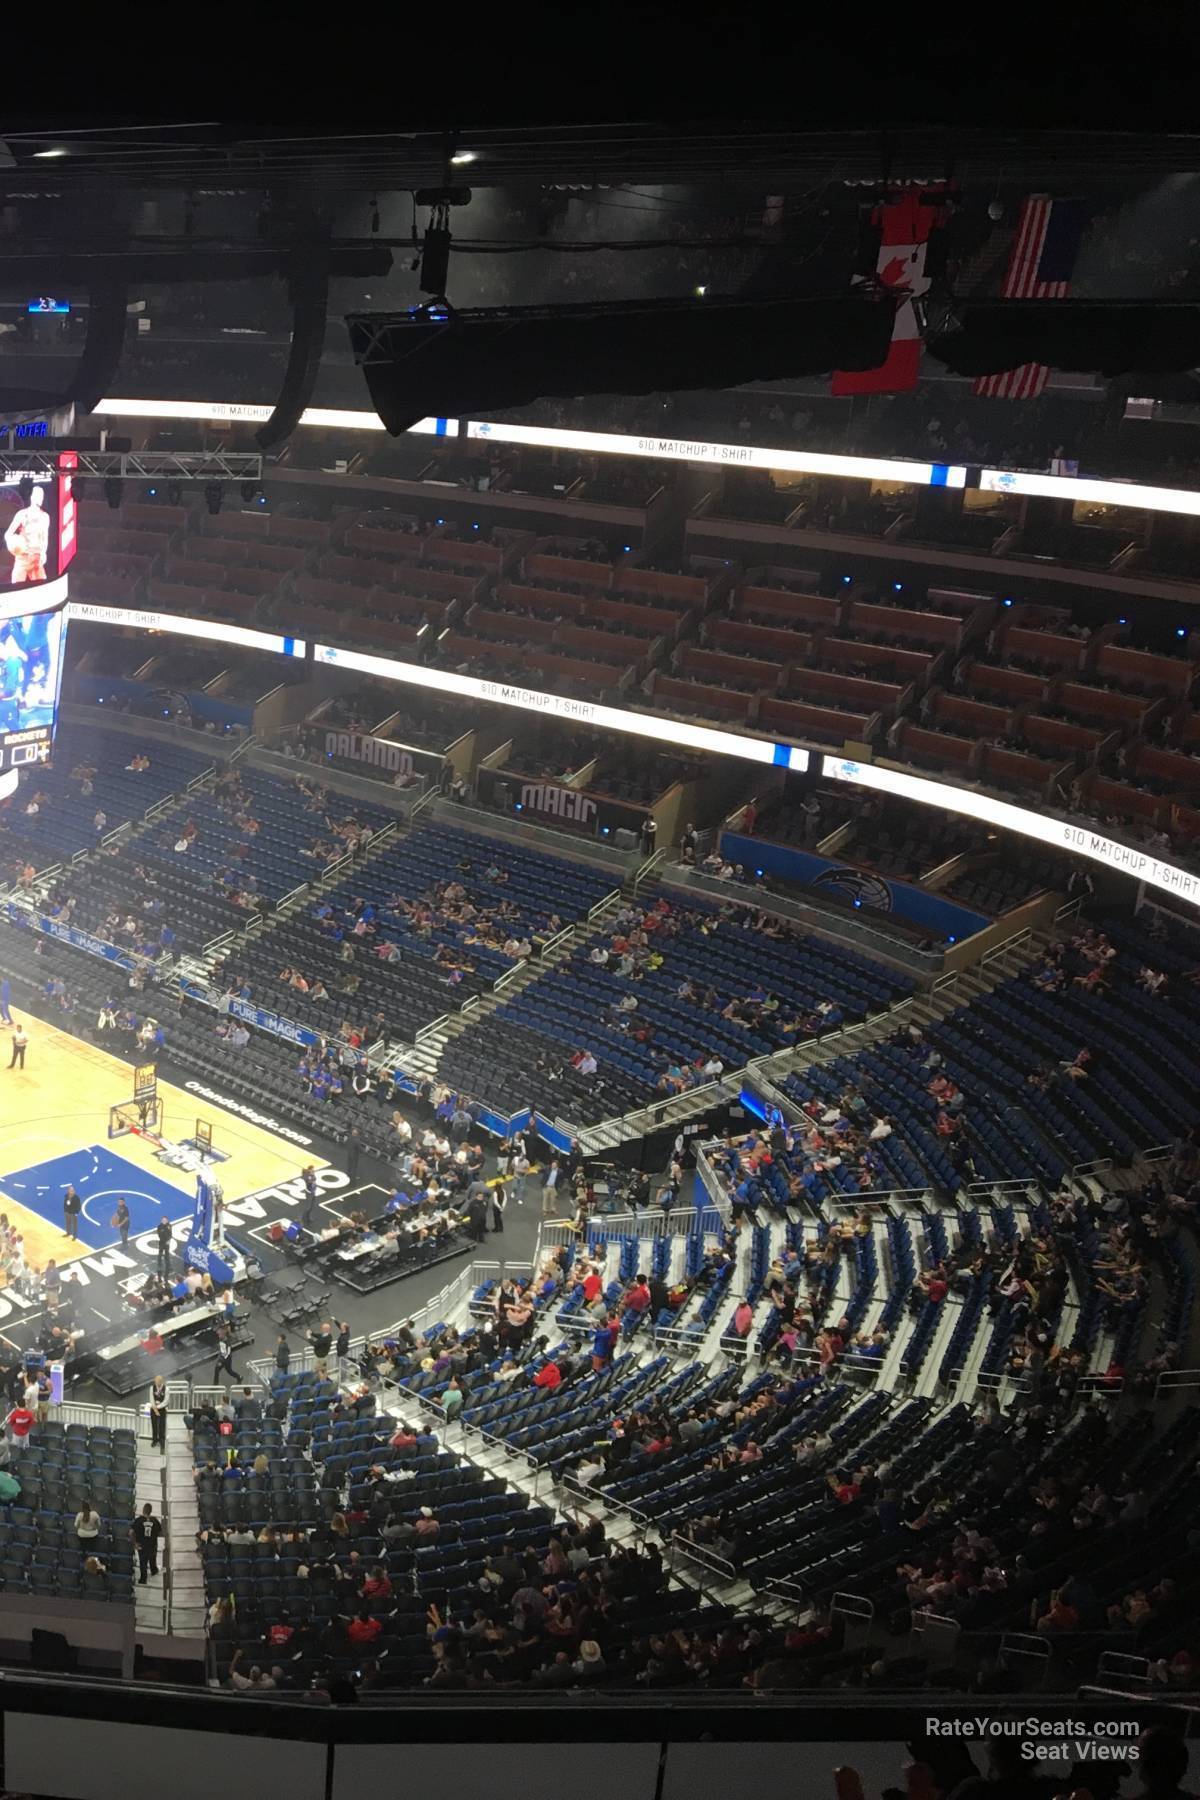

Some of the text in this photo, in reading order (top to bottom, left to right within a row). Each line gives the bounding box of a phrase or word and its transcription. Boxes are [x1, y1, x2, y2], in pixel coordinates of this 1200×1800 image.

[658, 441, 708, 456] MATCHUP
[81, 606, 123, 620] MATCHUP
[501, 687, 550, 707] MATCHUP
[325, 732, 414, 775] ORLANDO
[521, 784, 597, 822] MAGIC
[1063, 828, 1199, 895] $10 MATCHUP T-SHIRT
[231, 1001, 304, 1041] PURE MAGIC
[184, 1081, 313, 1146] OrlandoMagic.com
